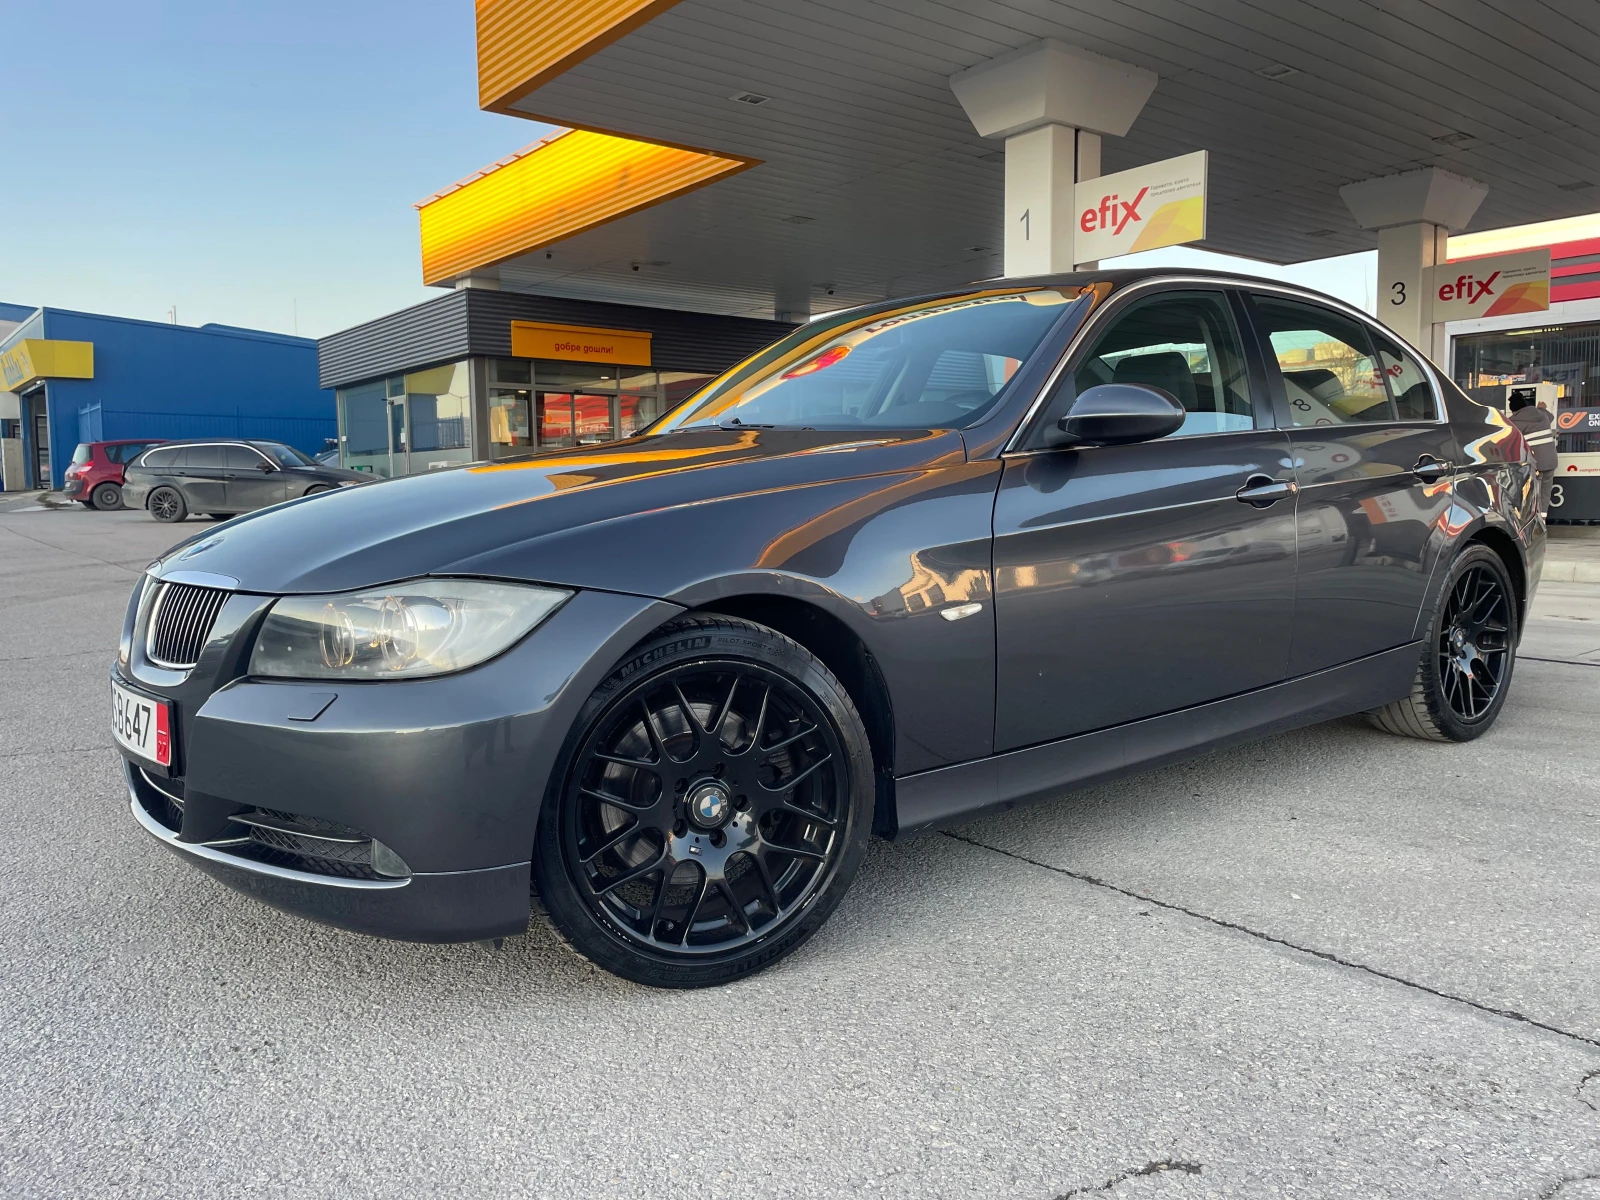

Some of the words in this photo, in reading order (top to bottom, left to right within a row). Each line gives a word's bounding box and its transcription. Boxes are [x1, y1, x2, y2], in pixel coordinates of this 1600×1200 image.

[1020, 208, 1029, 241] 1
[1080, 186, 1149, 236] efix
[1391, 282, 1406, 305] 3
[1438, 271, 1501, 304] efix
[554, 341, 581, 353] добре
[583, 345, 614, 354] дошли!
[1549, 484, 1565, 508] 3
[621, 636, 706, 679] MICHELIN
[743, 640, 768, 650] SPORT
